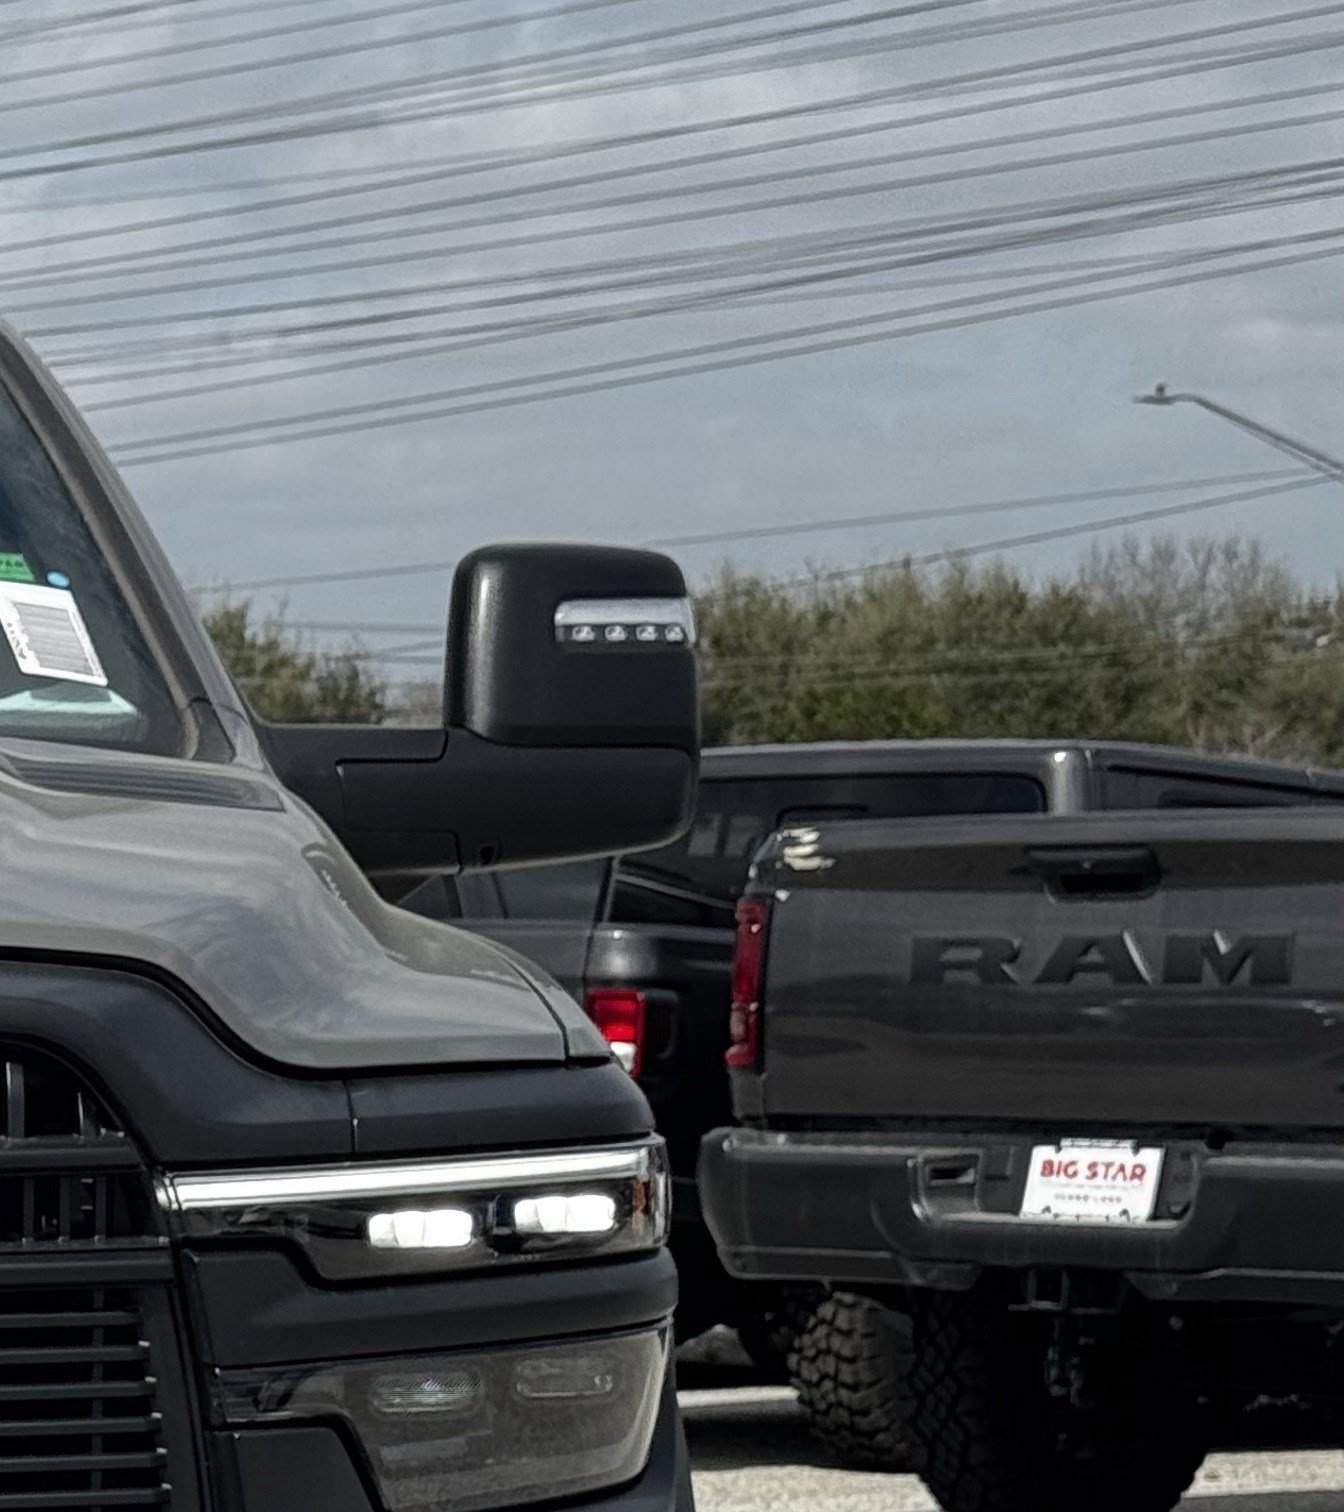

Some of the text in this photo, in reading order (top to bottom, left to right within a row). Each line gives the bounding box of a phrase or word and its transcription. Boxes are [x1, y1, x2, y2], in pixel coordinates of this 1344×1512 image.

[910, 930, 1295, 985] RAM
[1039, 1158, 1147, 1182] BIG STAR
